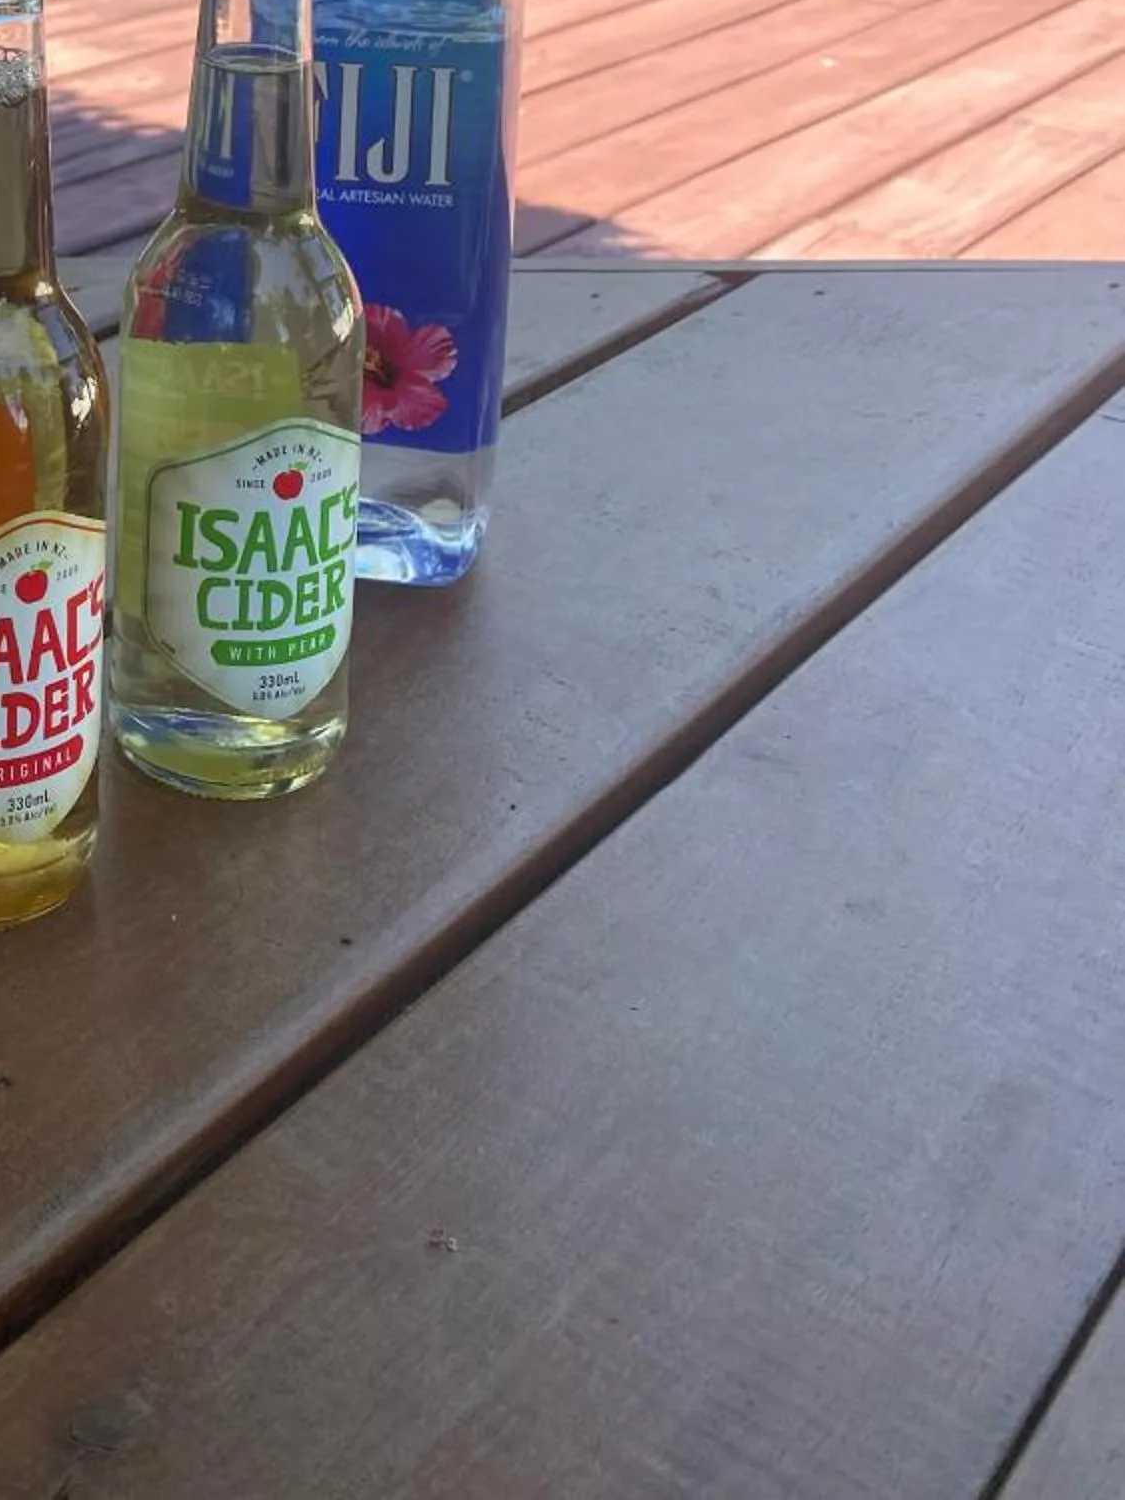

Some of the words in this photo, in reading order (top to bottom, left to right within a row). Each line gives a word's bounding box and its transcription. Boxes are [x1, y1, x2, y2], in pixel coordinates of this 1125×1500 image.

[339, 189, 405, 204] ARTESIAN
[408, 193, 455, 208] WATER
[36, 540, 49, 552] IN
[197, 559, 347, 632] CIDER
[228, 645, 277, 661] WITH
[287, 632, 327, 657] PEAR
